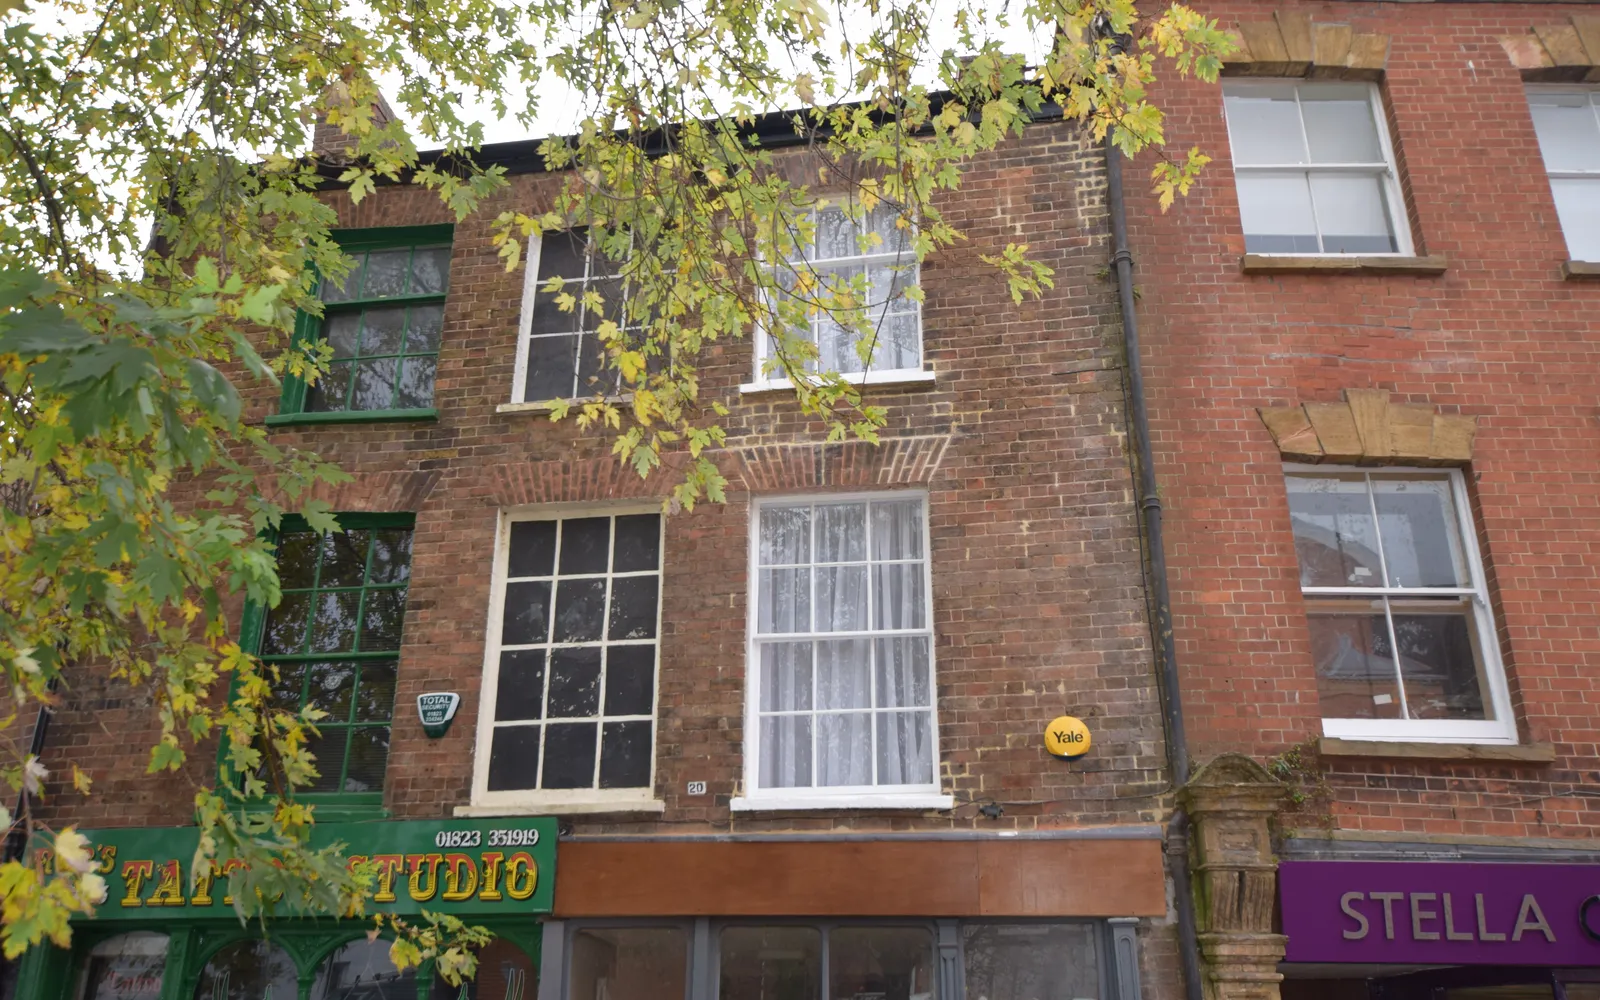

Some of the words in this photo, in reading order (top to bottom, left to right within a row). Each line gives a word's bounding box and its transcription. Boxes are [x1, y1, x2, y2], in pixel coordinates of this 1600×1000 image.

[422, 695, 451, 705] TOTAL
[1053, 731, 1083, 743] Yale
[689, 783, 704, 794] 20
[435, 830, 482, 848] 01823
[488, 828, 540, 847] 351919
[1340, 891, 1557, 942] STELLA
